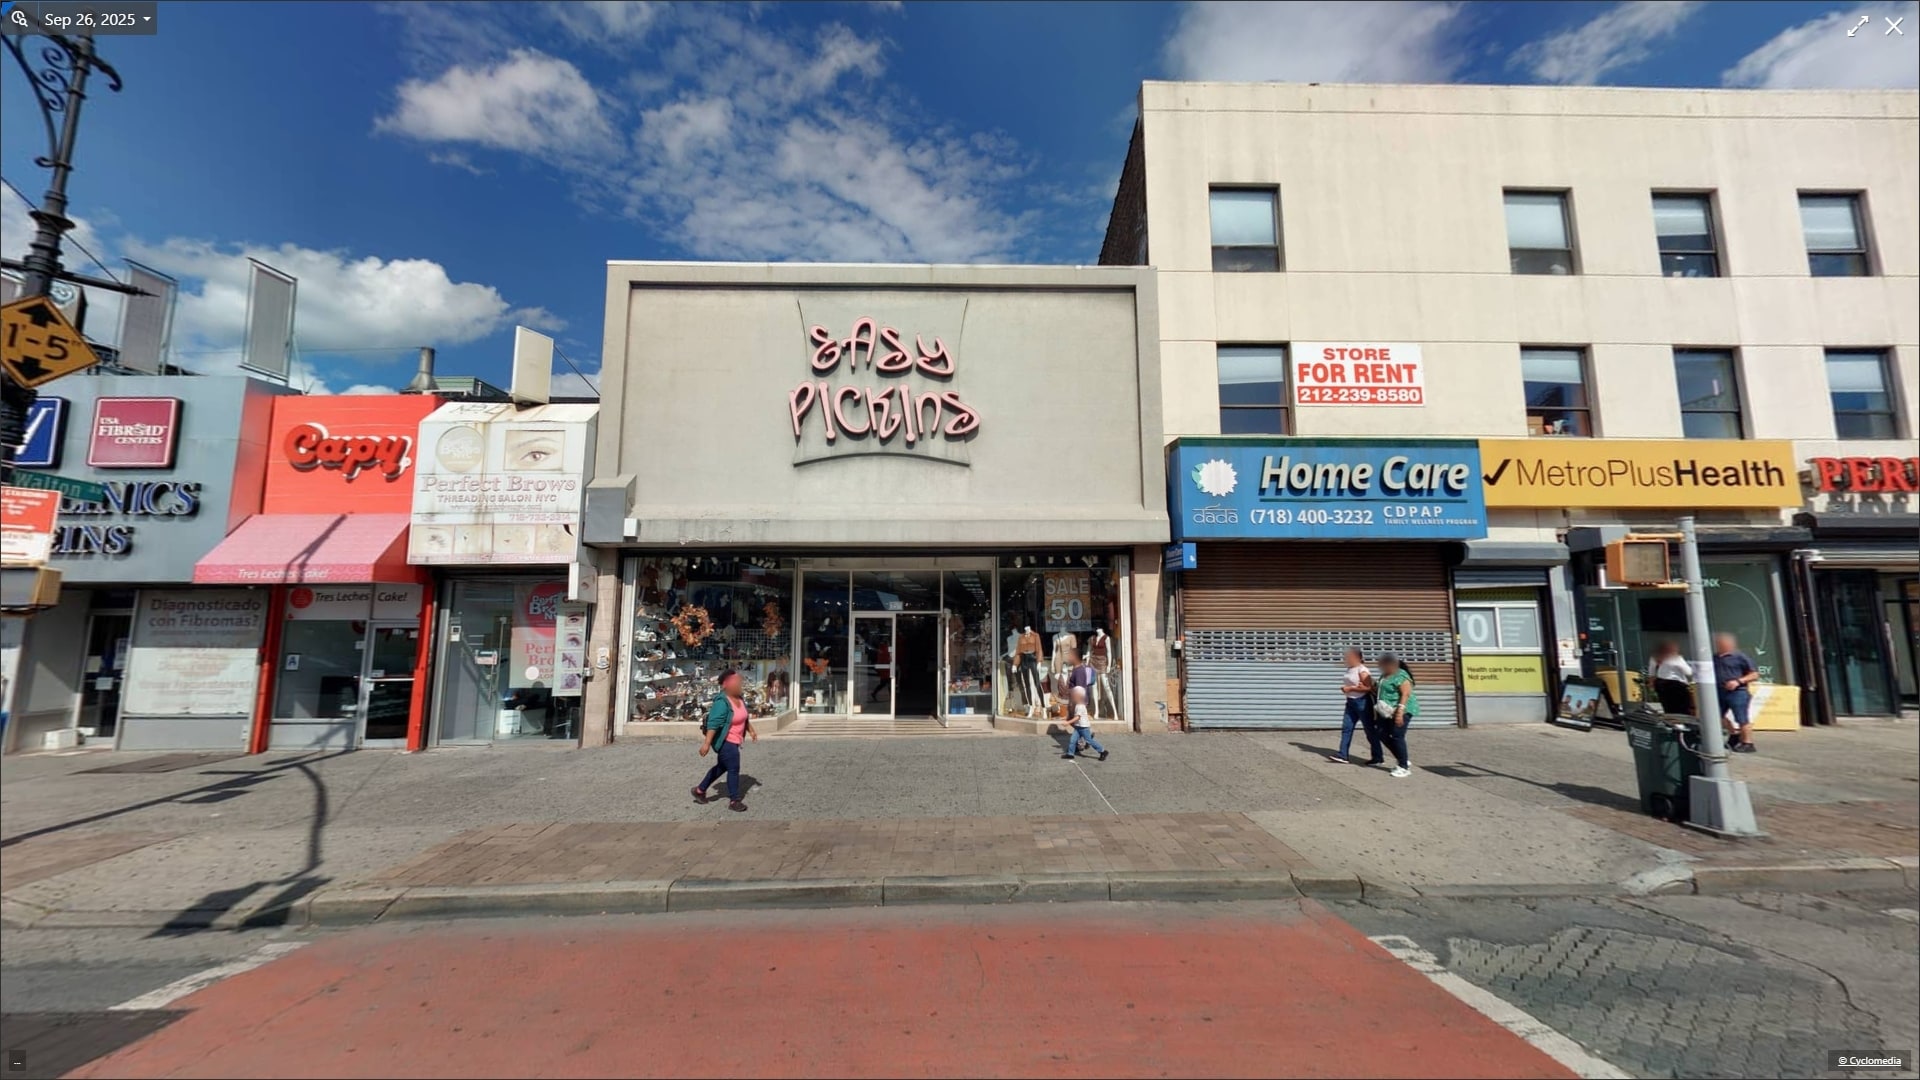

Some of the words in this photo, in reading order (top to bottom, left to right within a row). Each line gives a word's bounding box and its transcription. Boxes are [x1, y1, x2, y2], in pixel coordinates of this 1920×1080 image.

[809, 316, 955, 376] EASY
[1323, 348, 1391, 361] STORE
[1298, 363, 1346, 383] FOR
[1354, 363, 1417, 383] RENT
[1300, 388, 1420, 402] 212-239-8580
[99, 416, 119, 425] USA
[115, 437, 164, 445] CENTERS
[283, 423, 411, 481] Capy
[1260, 455, 1373, 491] Home
[1382, 455, 1469, 491] Care
[1516, 459, 1785, 487] MetroPlusHealth
[15, 473, 81, 497] Walton
[420, 475, 502, 492] Perfect
[506, 475, 577, 492] Brows
[437, 494, 497, 503] THREADING
[499, 494, 532, 502] SALON
[535, 494, 557, 502] NYC
[1250, 509, 1293, 526] (718)
[1297, 510, 1374, 525] 400-3232
[52, 525, 129, 553] INS
[238, 568, 257, 579] Tres
[260, 568, 297, 579] Leches
[1045, 577, 1090, 595] SALE
[315, 592, 334, 602] Tres
[336, 591, 370, 602] Leches
[377, 591, 408, 602] Cake!
[150, 598, 261, 614] Diagnosticado
[1051, 598, 1084, 620] 50
[149, 616, 176, 627] con
[180, 613, 260, 627] Fibromas?
[288, 656, 297, 667] A
